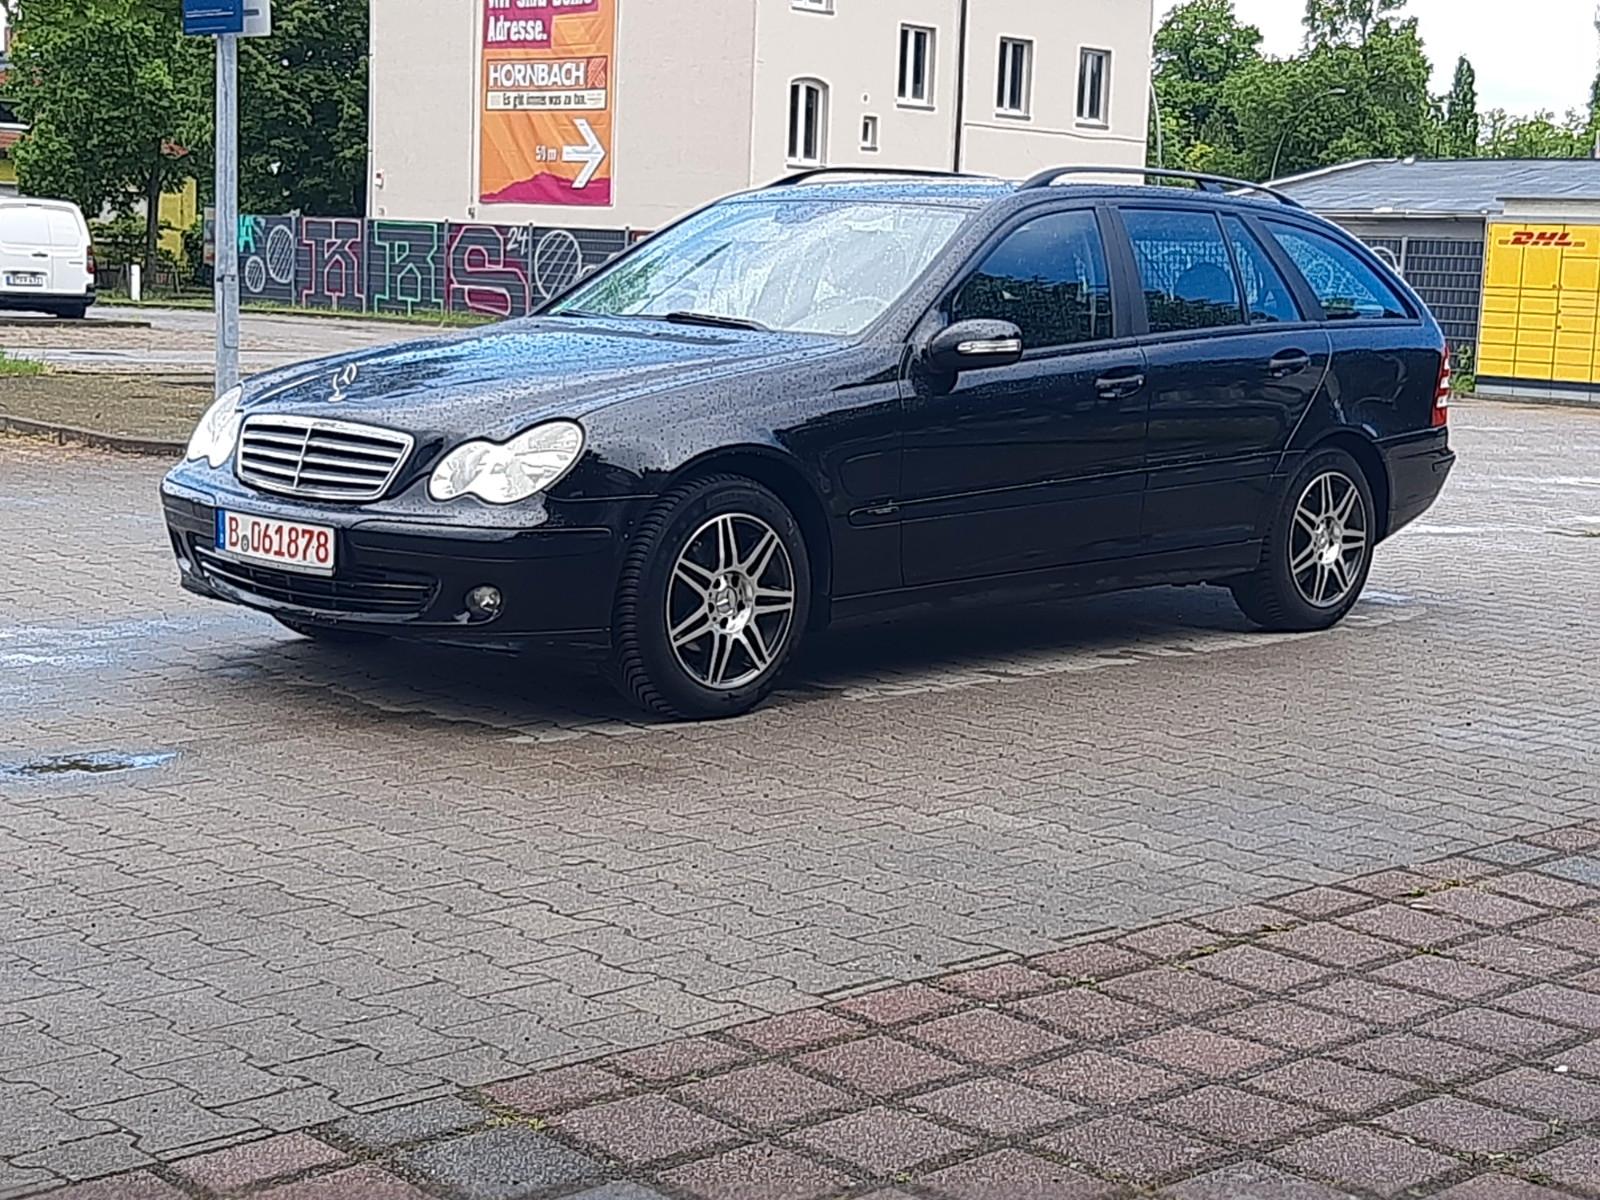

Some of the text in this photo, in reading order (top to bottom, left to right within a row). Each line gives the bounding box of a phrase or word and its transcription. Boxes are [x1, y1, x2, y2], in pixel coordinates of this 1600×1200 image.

[487, 15, 548, 42] Adresse.
[488, 62, 585, 87] HORNBACH
[507, 227, 529, 254] 24
[1510, 231, 1571, 247] DHL
[228, 516, 330, 564] B 061878
